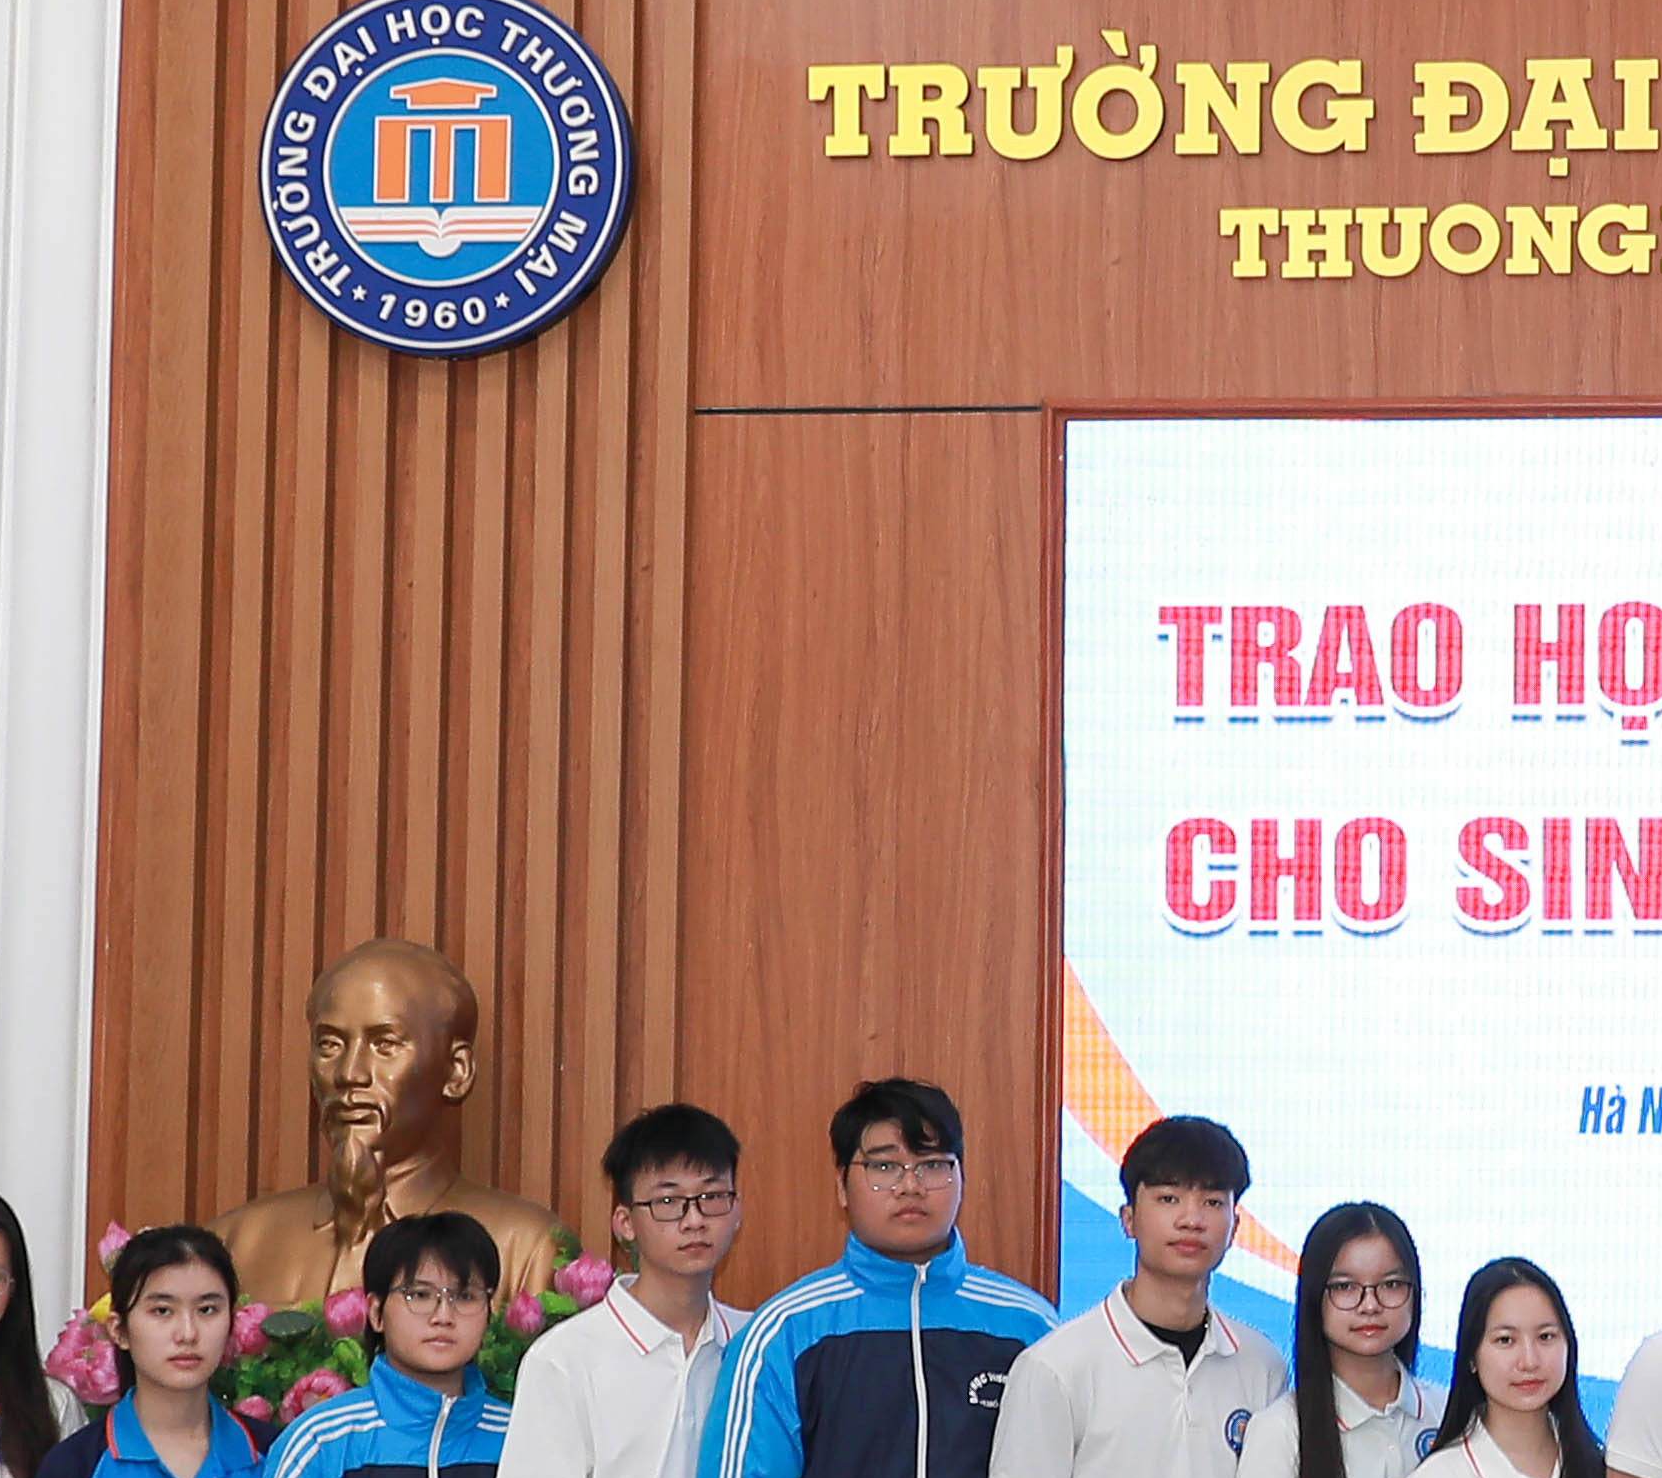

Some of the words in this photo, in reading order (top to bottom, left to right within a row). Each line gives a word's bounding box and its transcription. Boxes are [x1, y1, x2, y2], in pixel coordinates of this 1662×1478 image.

[302, 26, 378, 102] ĐẠI
[384, 4, 485, 45] HỌC
[502, 18, 600, 197] THƯƠNG
[808, 30, 1374, 161] TRƯỜNG
[1413, 58, 1659, 175] ĐẠI
[272, 110, 352, 297] TRƯỜNG
[513, 209, 588, 297] MẠI
[378, 293, 488, 329] 1960
[1158, 601, 1464, 719] TRAO
[1163, 816, 1408, 928] CHO
[1579, 1084, 1627, 1135] Hà
